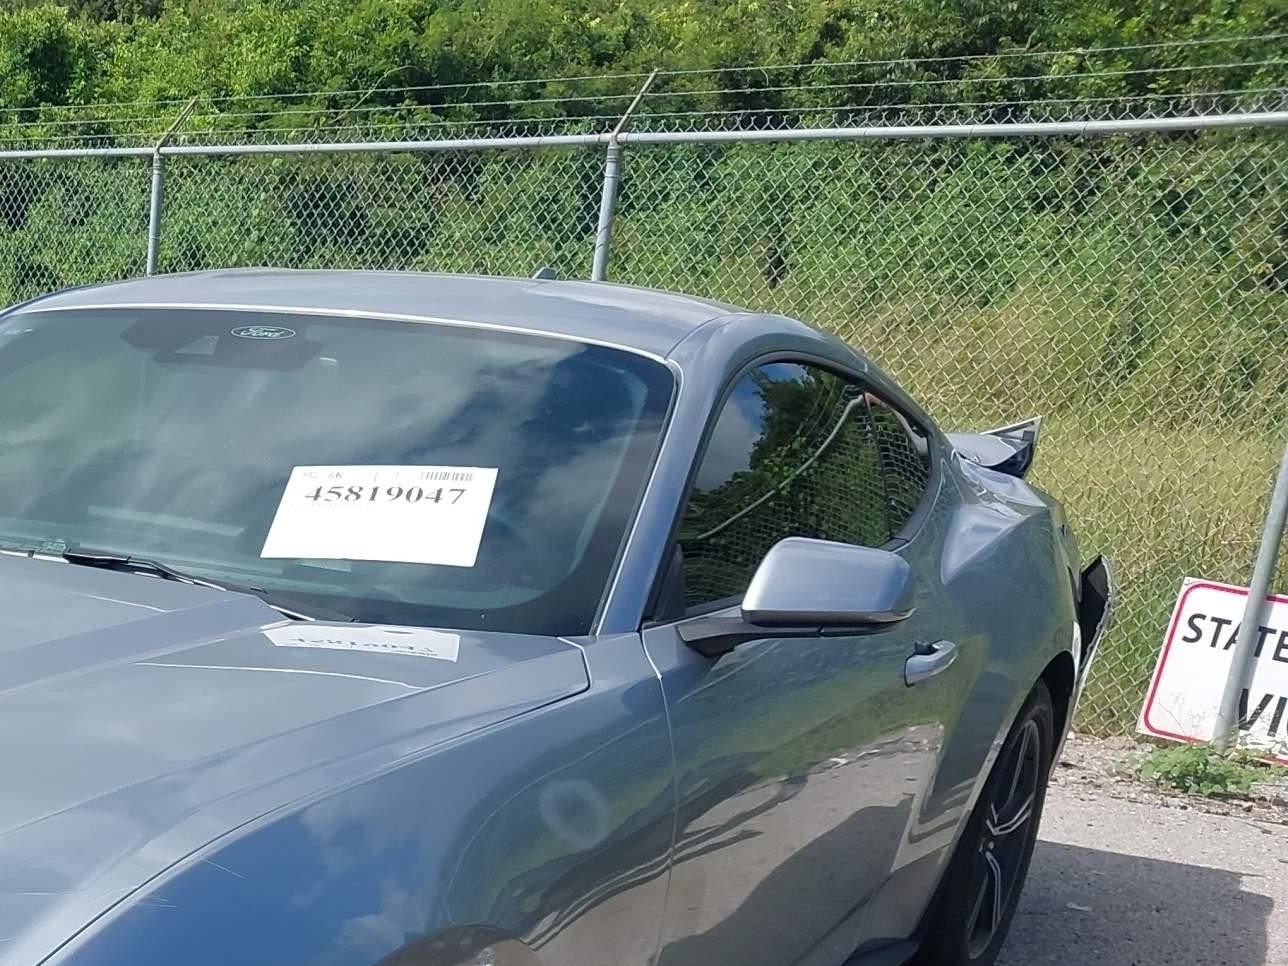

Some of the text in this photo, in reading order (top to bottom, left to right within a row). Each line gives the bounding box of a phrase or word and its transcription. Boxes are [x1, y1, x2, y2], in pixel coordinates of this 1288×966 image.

[240, 326, 286, 339] Ford
[304, 485, 467, 505] 45819047
[1238, 687, 1288, 738] VI
